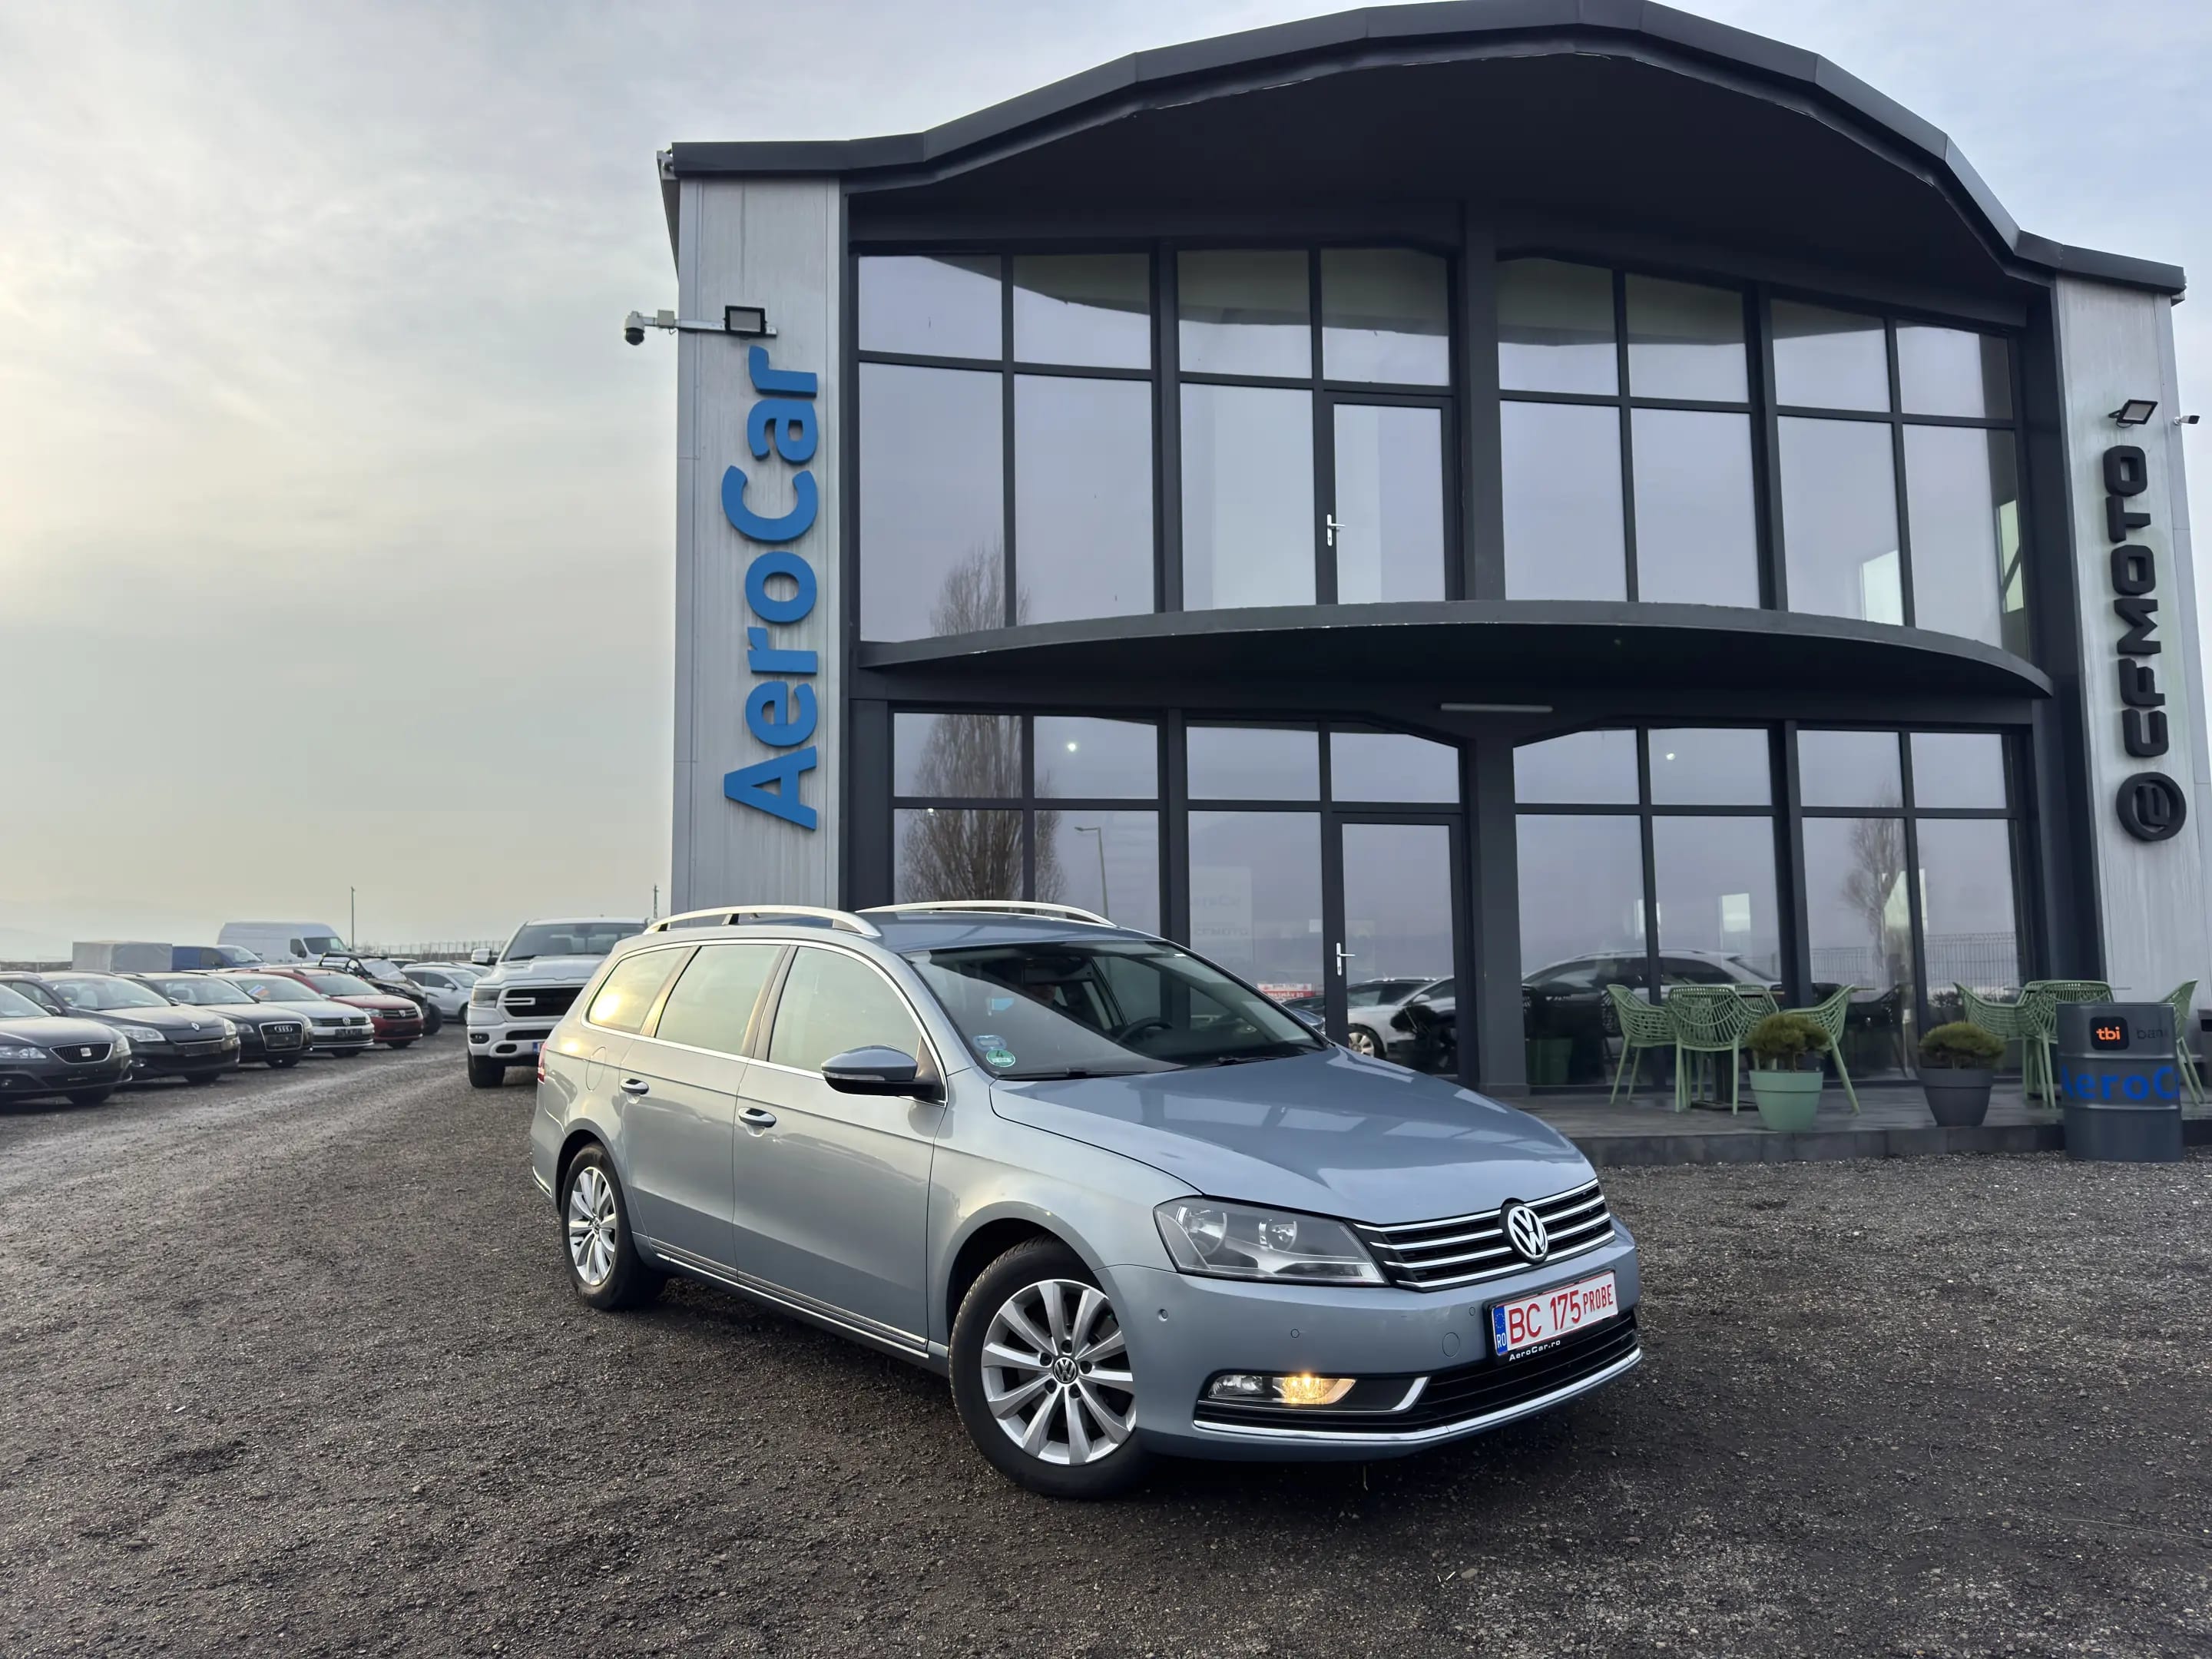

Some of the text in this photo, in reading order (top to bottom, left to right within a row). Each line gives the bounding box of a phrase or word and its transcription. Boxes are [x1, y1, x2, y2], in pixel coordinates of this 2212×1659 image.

[722, 345, 818, 830] AeroCar
[2103, 445, 2169, 757] CFMOTO
[2096, 1026, 2167, 1040] tbi ban
[2061, 1065, 2180, 1100] AeroC
[1508, 1283, 1614, 1344] BC 175 PROBE
[1496, 1333, 1507, 1349] RO
[1509, 1339, 1561, 1361] AeroCar.ro
